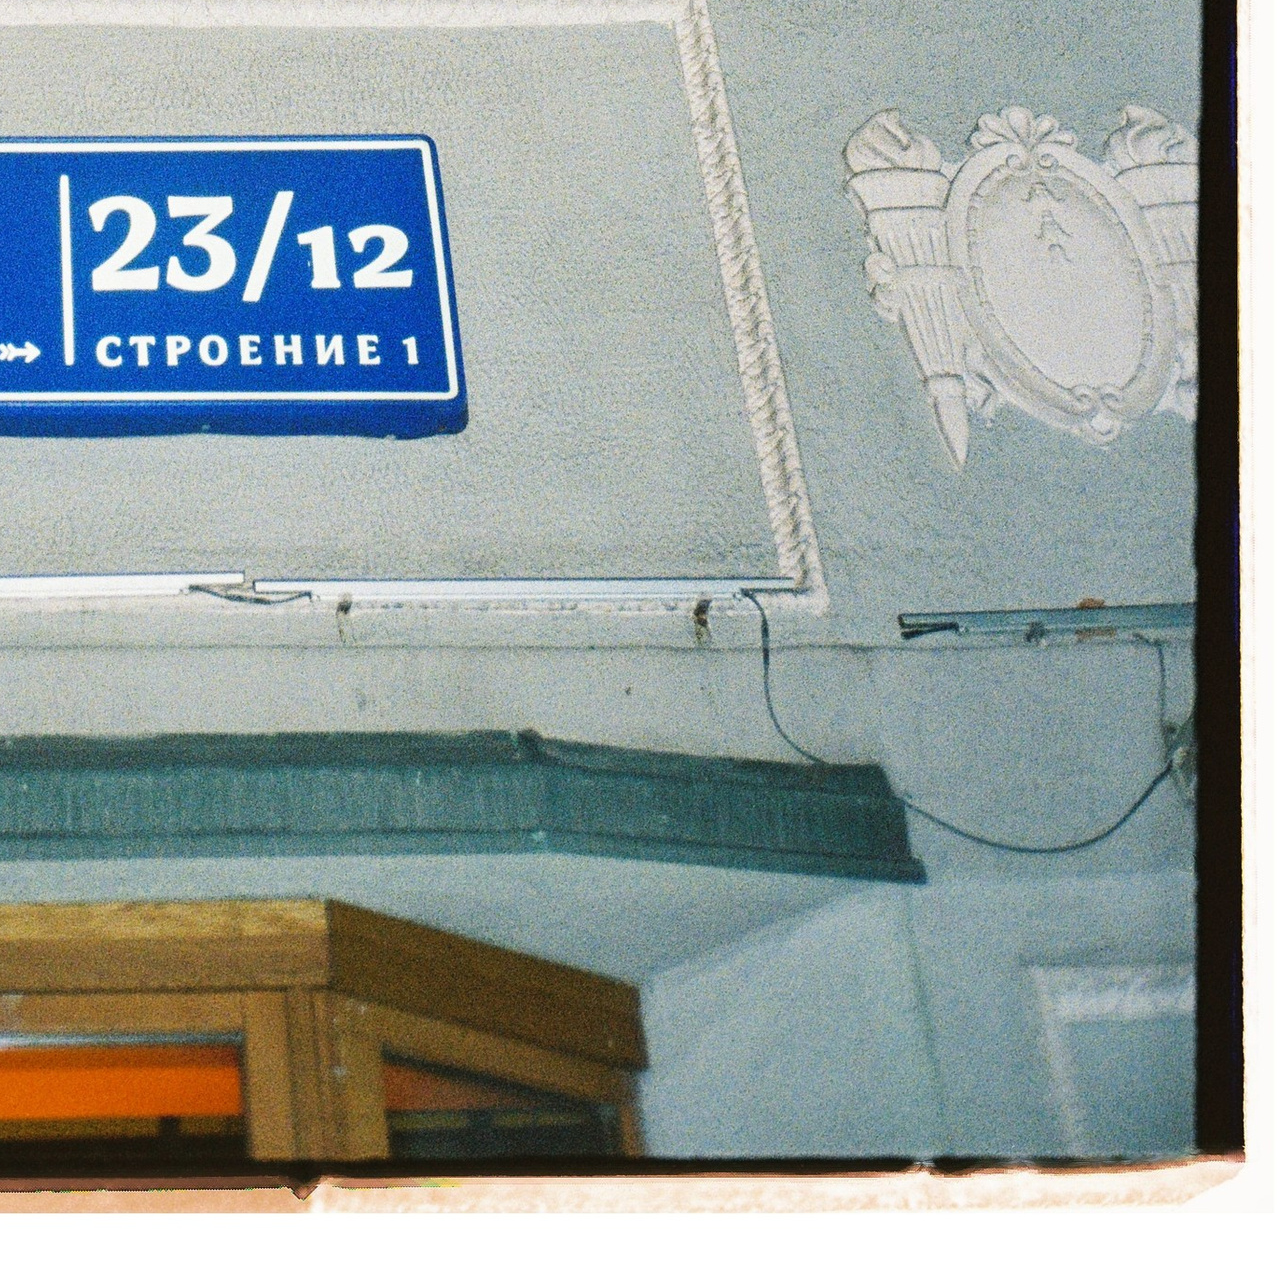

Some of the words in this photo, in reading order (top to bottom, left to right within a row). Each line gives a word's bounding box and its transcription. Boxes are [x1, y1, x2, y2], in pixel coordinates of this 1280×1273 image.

[87, 189, 414, 303] 23/12
[95, 334, 381, 368] СТРОЕНИЕ
[402, 336, 419, 365] 1
